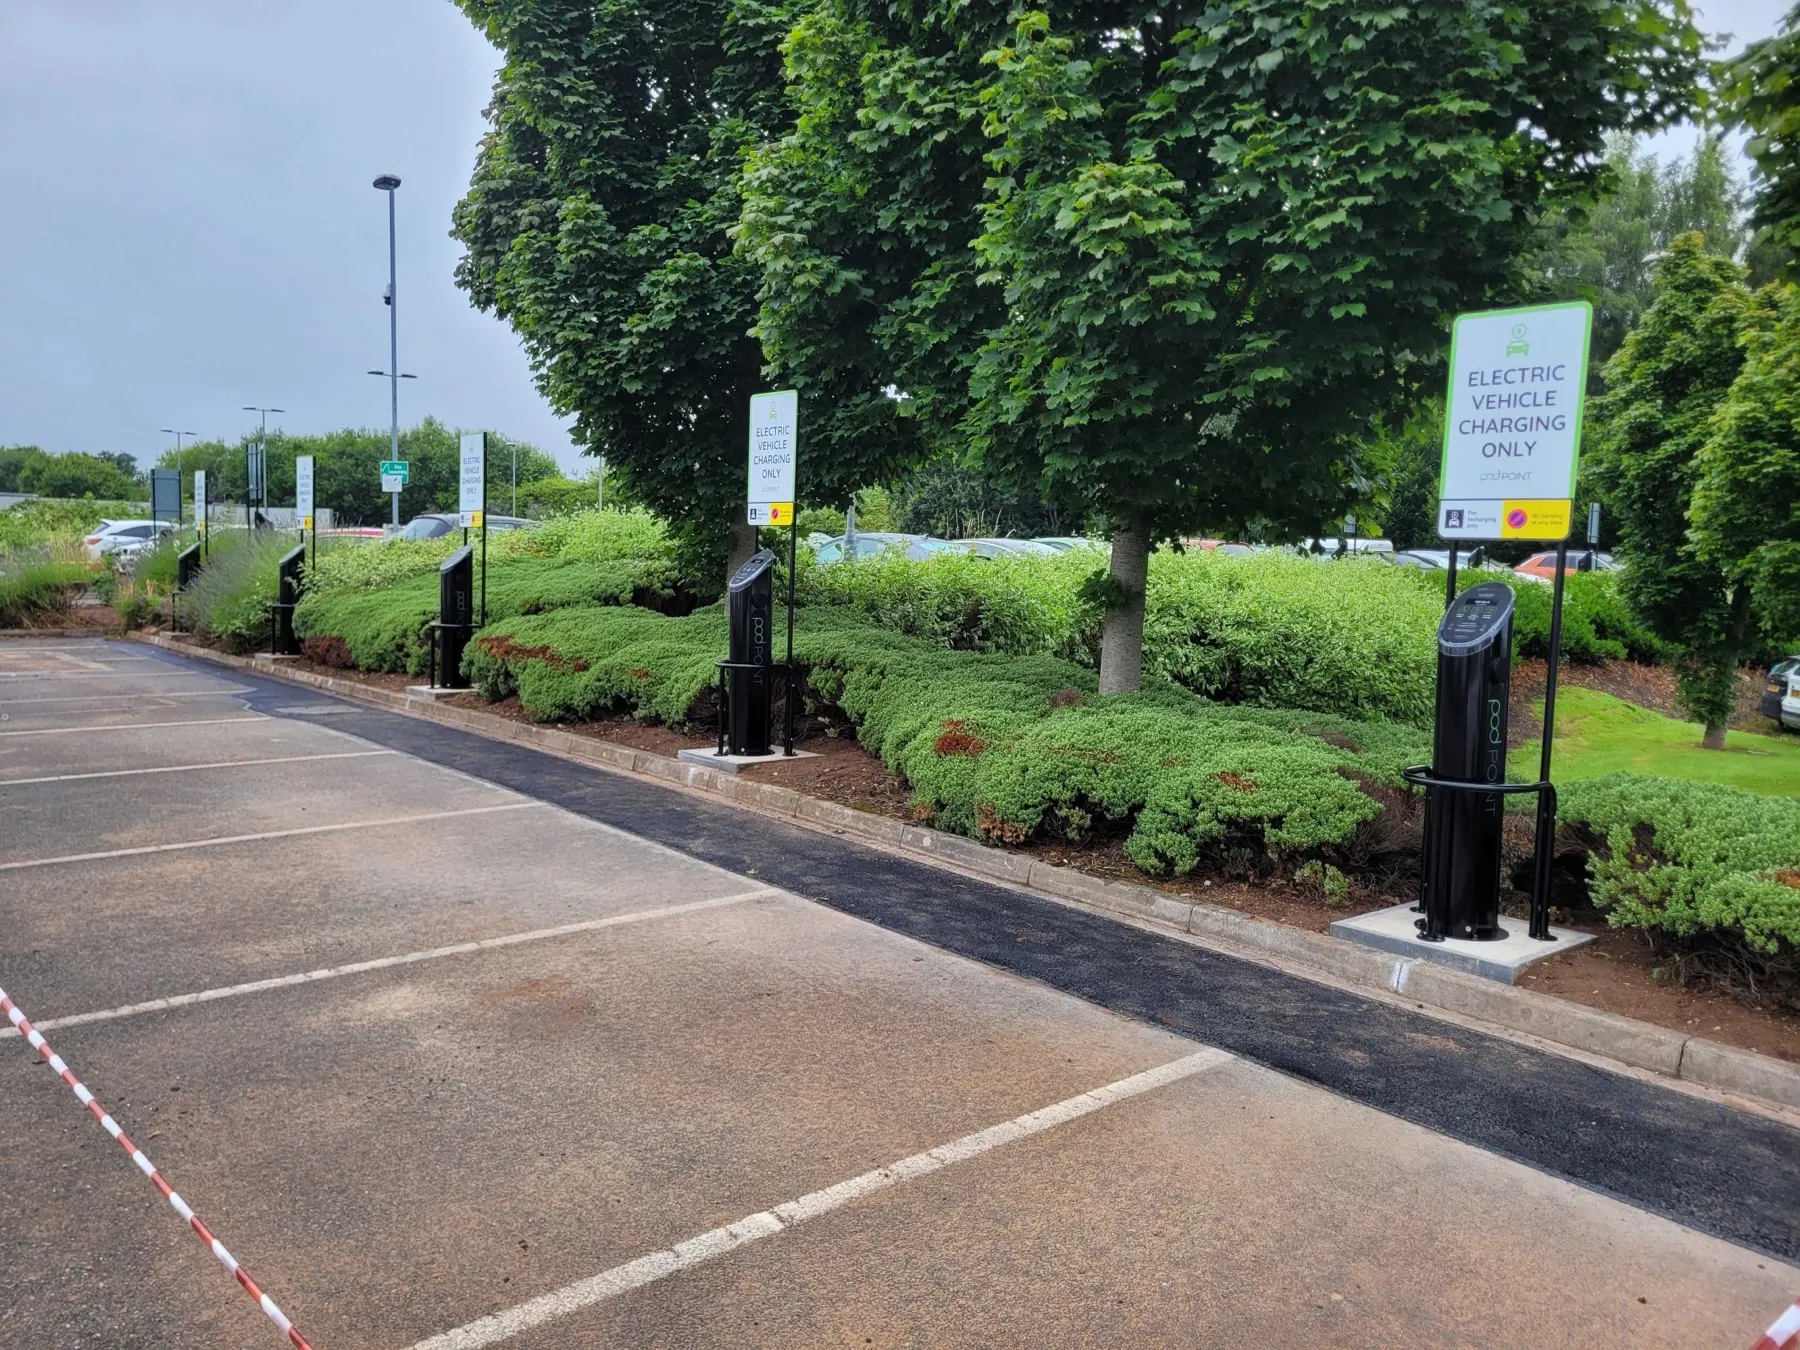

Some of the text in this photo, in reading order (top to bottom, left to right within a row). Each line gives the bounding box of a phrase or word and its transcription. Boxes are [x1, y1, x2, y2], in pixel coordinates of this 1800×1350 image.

[1468, 364, 1566, 387] ELECTRIC
[1472, 390, 1556, 410] VEHICLE
[756, 426, 790, 437] ELECTRIC
[1458, 414, 1566, 435] CHARGING
[758, 440, 787, 450] VEHICLE
[1482, 440, 1537, 458] ONLY
[463, 456, 480, 465] ELECTRIC
[754, 454, 790, 465] CHARGING
[762, 468, 781, 478] ONLY
[1502, 472, 1532, 480] POINT
[752, 617, 767, 686] pod PONT
[1488, 699, 1502, 744] pod
